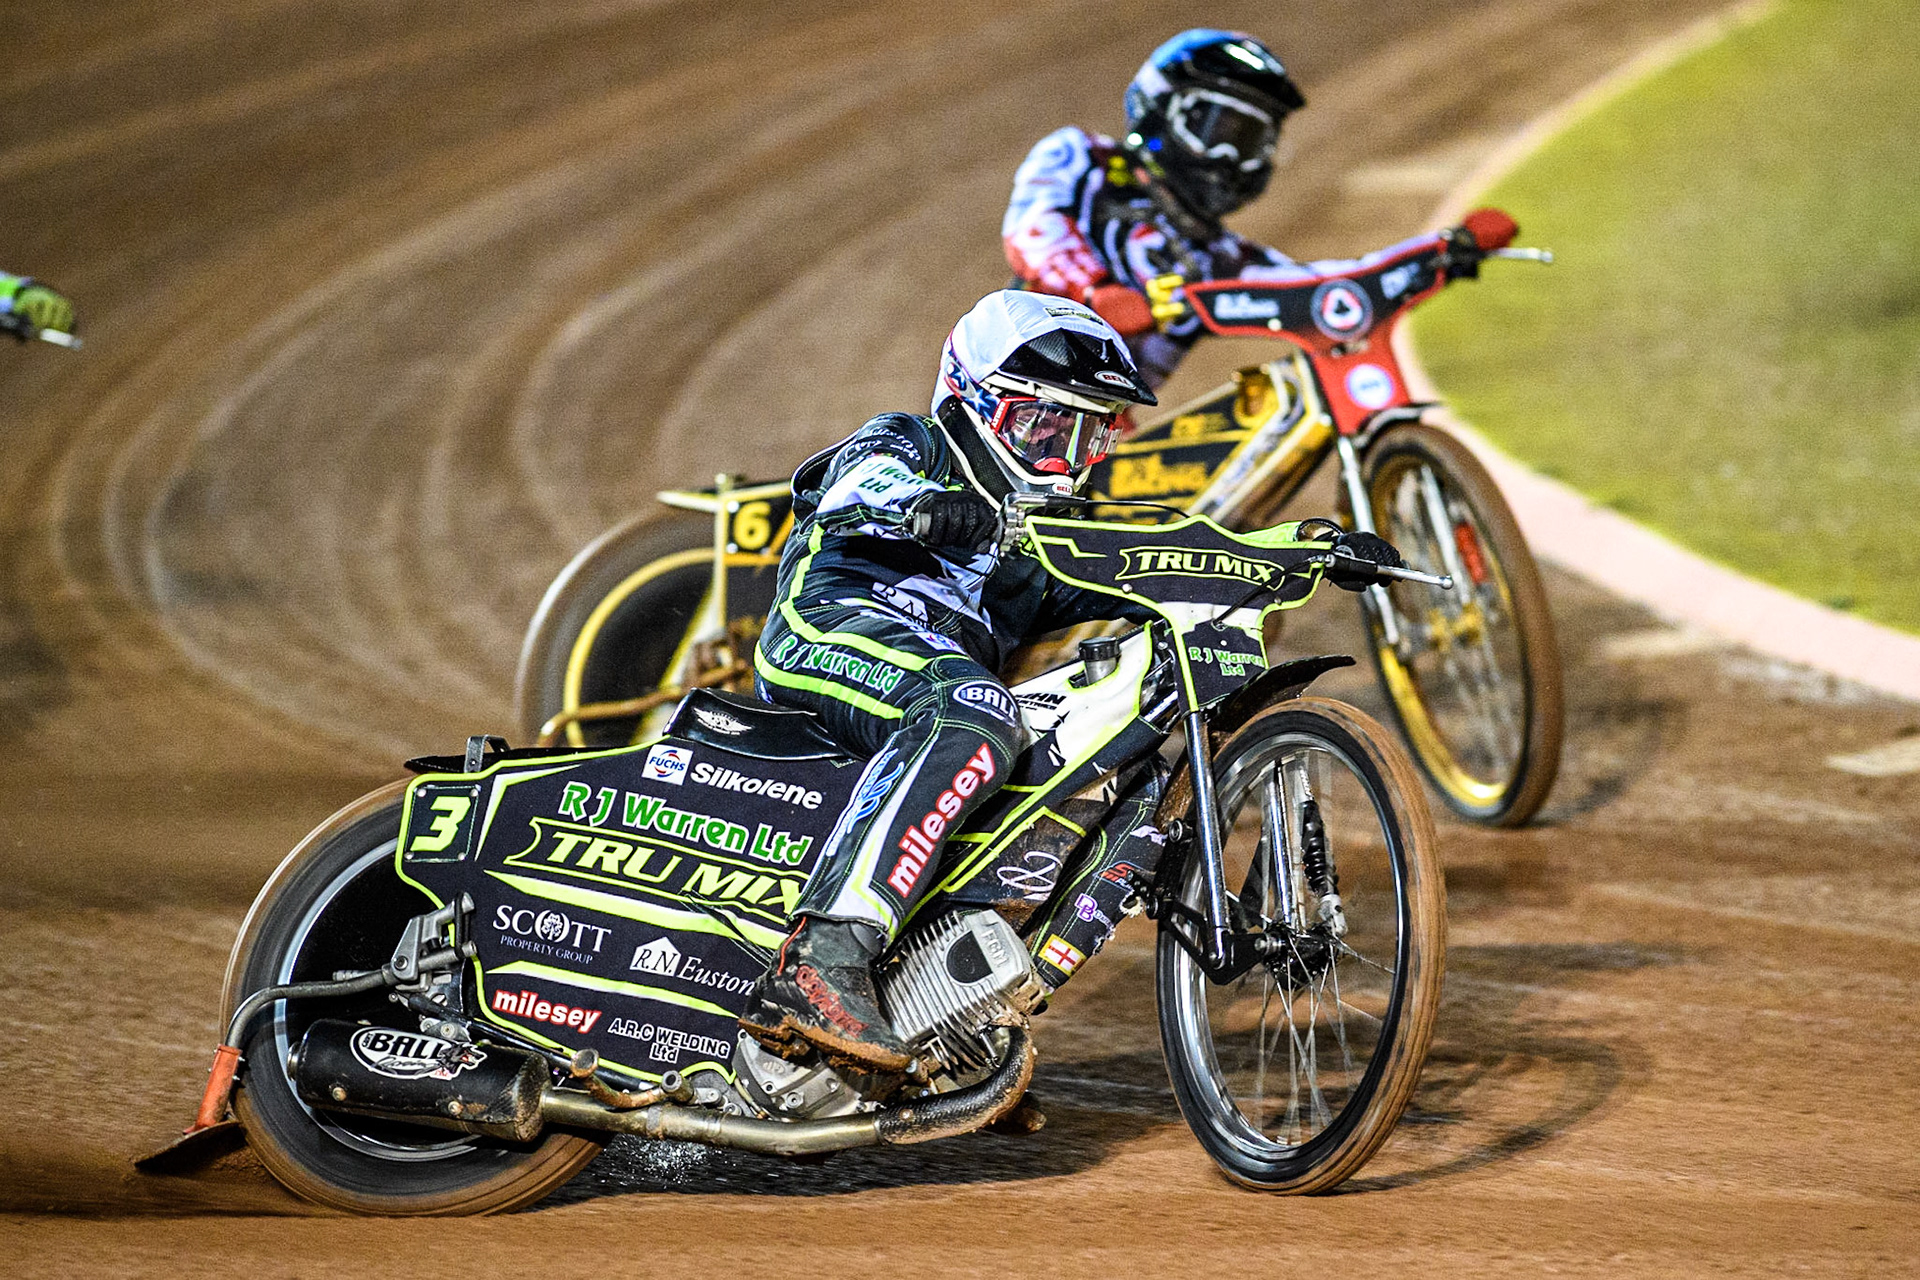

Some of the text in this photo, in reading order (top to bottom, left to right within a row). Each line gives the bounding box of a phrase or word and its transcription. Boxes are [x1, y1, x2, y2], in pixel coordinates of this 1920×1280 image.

[1102, 374, 1131, 387] BELL
[733, 501, 771, 549] 6
[1136, 551, 1276, 583] TRU MIX
[802, 644, 872, 683] Warren
[865, 661, 905, 695] Ltd
[1213, 649, 1265, 668] Warren
[1220, 663, 1246, 676] Ltd
[966, 686, 1016, 721] BALL
[648, 755, 686, 772] FUCHS
[690, 762, 823, 810] Silkolene
[410, 796, 471, 852] 3
[622, 791, 750, 855] Warren
[749, 823, 814, 866] Ltd
[887, 743, 996, 898] milesey
[545, 831, 804, 915] TRU MIX
[493, 905, 612, 952] SCOTT
[500, 934, 594, 965] PROPERTY GROUP
[632, 944, 756, 996] R.N. Euston
[491, 989, 602, 1034] milesey
[368, 1032, 447, 1060] BALL
[649, 1042, 679, 1064] Ltd
[655, 1026, 731, 1054] WELDING
